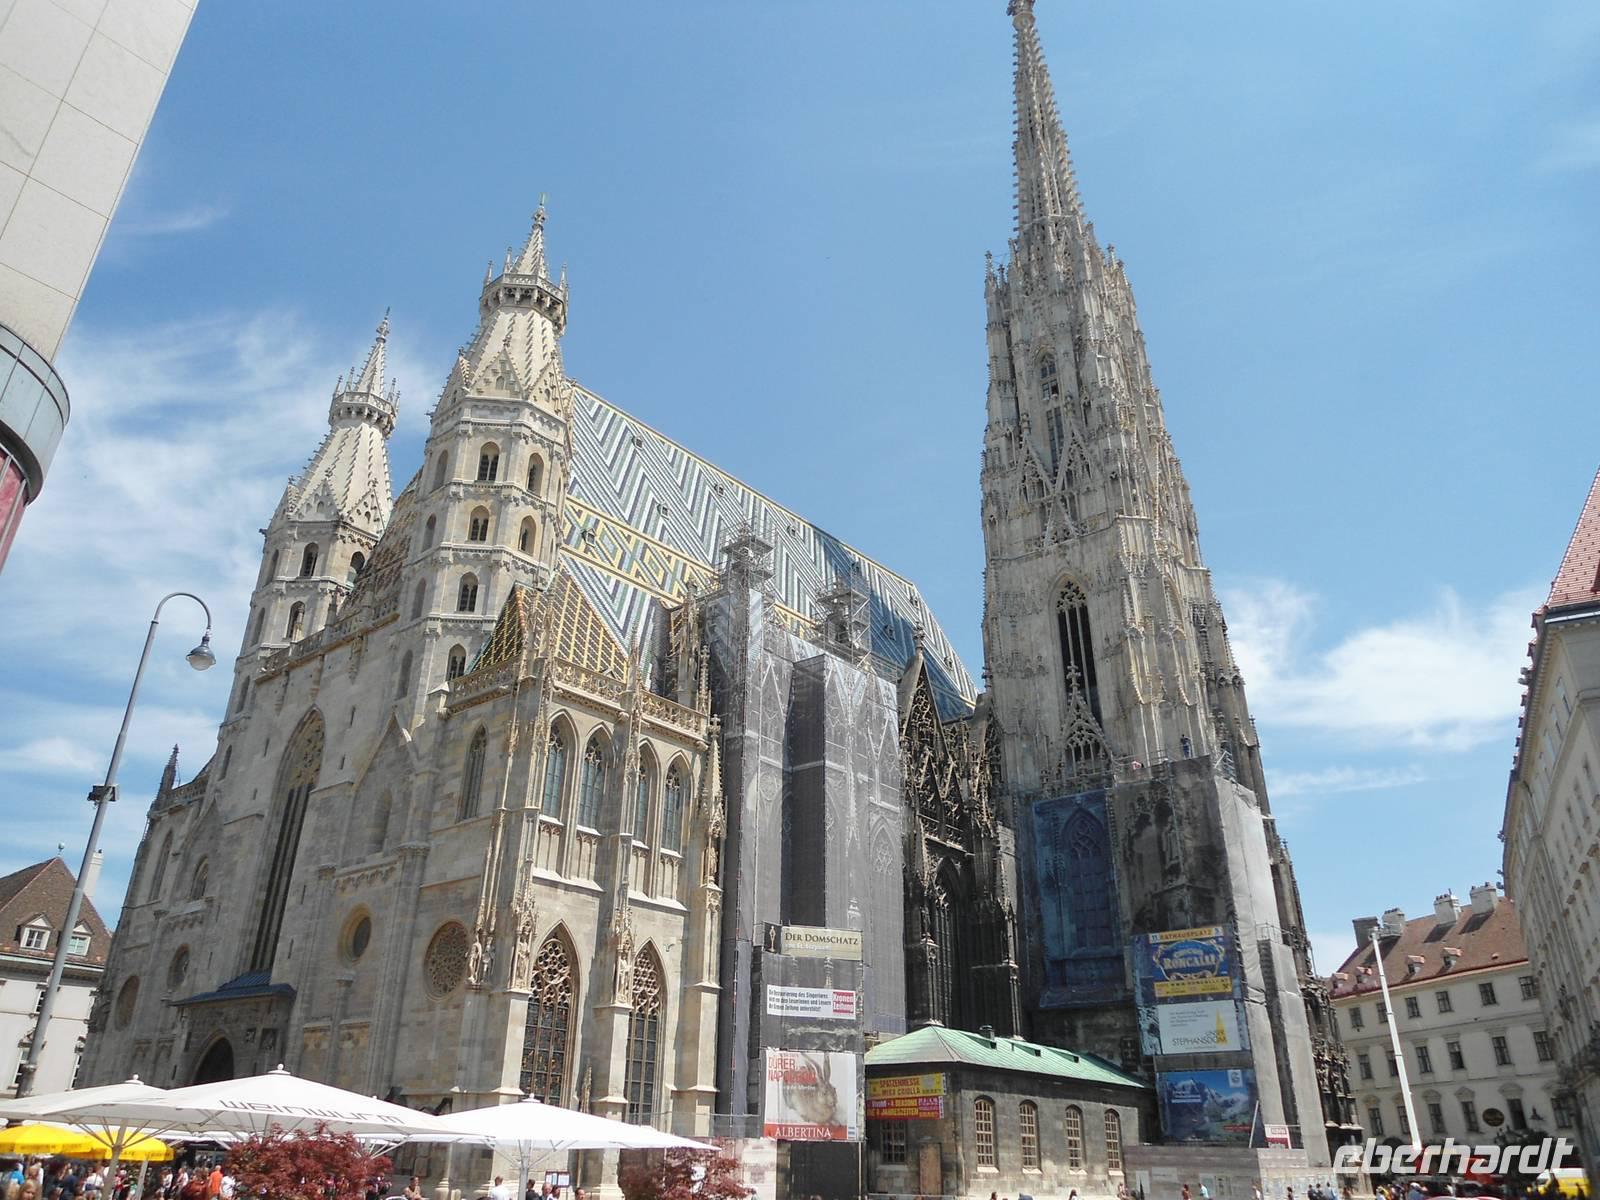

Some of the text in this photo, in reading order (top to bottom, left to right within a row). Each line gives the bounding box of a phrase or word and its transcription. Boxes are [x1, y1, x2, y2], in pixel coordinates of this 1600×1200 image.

[785, 932, 858, 946] DER DOMSCHATZ
[219, 1099, 405, 1124] weinwurm
[775, 1127, 832, 1138] ALBERTINA
